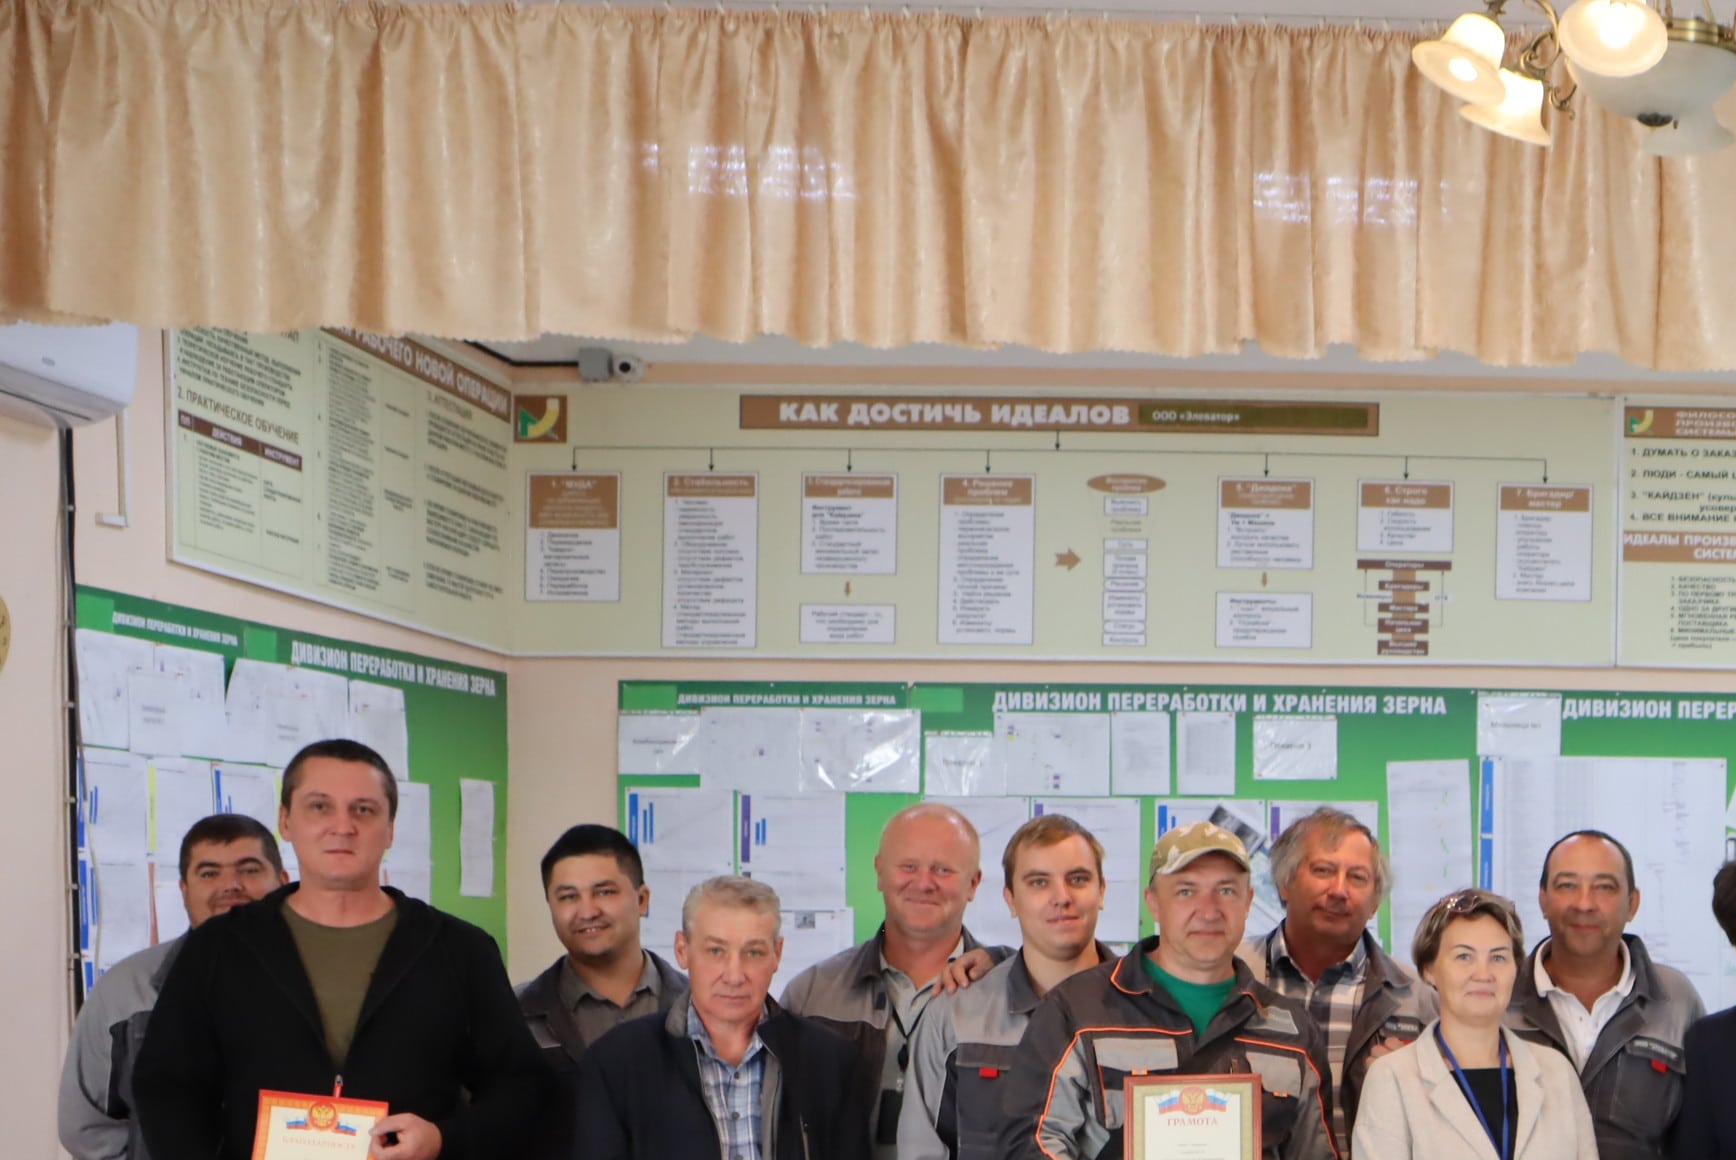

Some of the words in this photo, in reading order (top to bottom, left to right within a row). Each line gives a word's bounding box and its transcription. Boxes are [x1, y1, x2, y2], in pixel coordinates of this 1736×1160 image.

[416, 351, 454, 385] НОВОЙ
[187, 390, 253, 427] ПРАКТИЧЕСКОЕ
[255, 417, 299, 445] ОБУЧЕНИЕ
[779, 403, 839, 422] КАК
[848, 403, 981, 425] ДОСТИЧЬ
[991, 404, 1130, 426] ИДЕАЛОВ
[1152, 411, 1176, 421] ООО
[1642, 448, 1687, 457] ДУМАТЬ
[1691, 449, 1699, 457] О
[1643, 470, 1676, 479] ЛЮДИ
[1686, 470, 1728, 480] САМЫЙ
[1643, 490, 1705, 501] "КАЙДЗЕН"
[1643, 513, 1663, 522] ВСЕ
[1667, 513, 1729, 522] ВНИМАНИЕ
[1624, 535, 1680, 547] ИДЕАЛЫ
[291, 640, 348, 670] ДИВИЗИОН
[350, 651, 416, 682] ПЕРЕРАБОТКИ
[416, 664, 424, 682] И
[425, 666, 469, 692] ХРАНЕНИЯ
[470, 674, 496, 697] ЗЕРНА
[678, 694, 730, 705] ДИВИЗИОН
[732, 694, 800, 705] ПЕРЕРАБОТКИ
[802, 694, 810, 705] И
[812, 694, 863, 705] ХРАНЕНИЯ
[865, 694, 896, 705] ЗЕРНА
[992, 692, 1101, 712] ДИВИЗИОН
[1108, 692, 1247, 712] ПЕРЕРАБОТКИ
[1253, 694, 1267, 712] И
[1272, 694, 1378, 714] ХРАНЕНИЯ
[1382, 696, 1447, 714] ЗЕРНА
[1562, 698, 1672, 720] ДИВИЗИОН
[1166, 1118, 1218, 1127] ГРАМОТА
